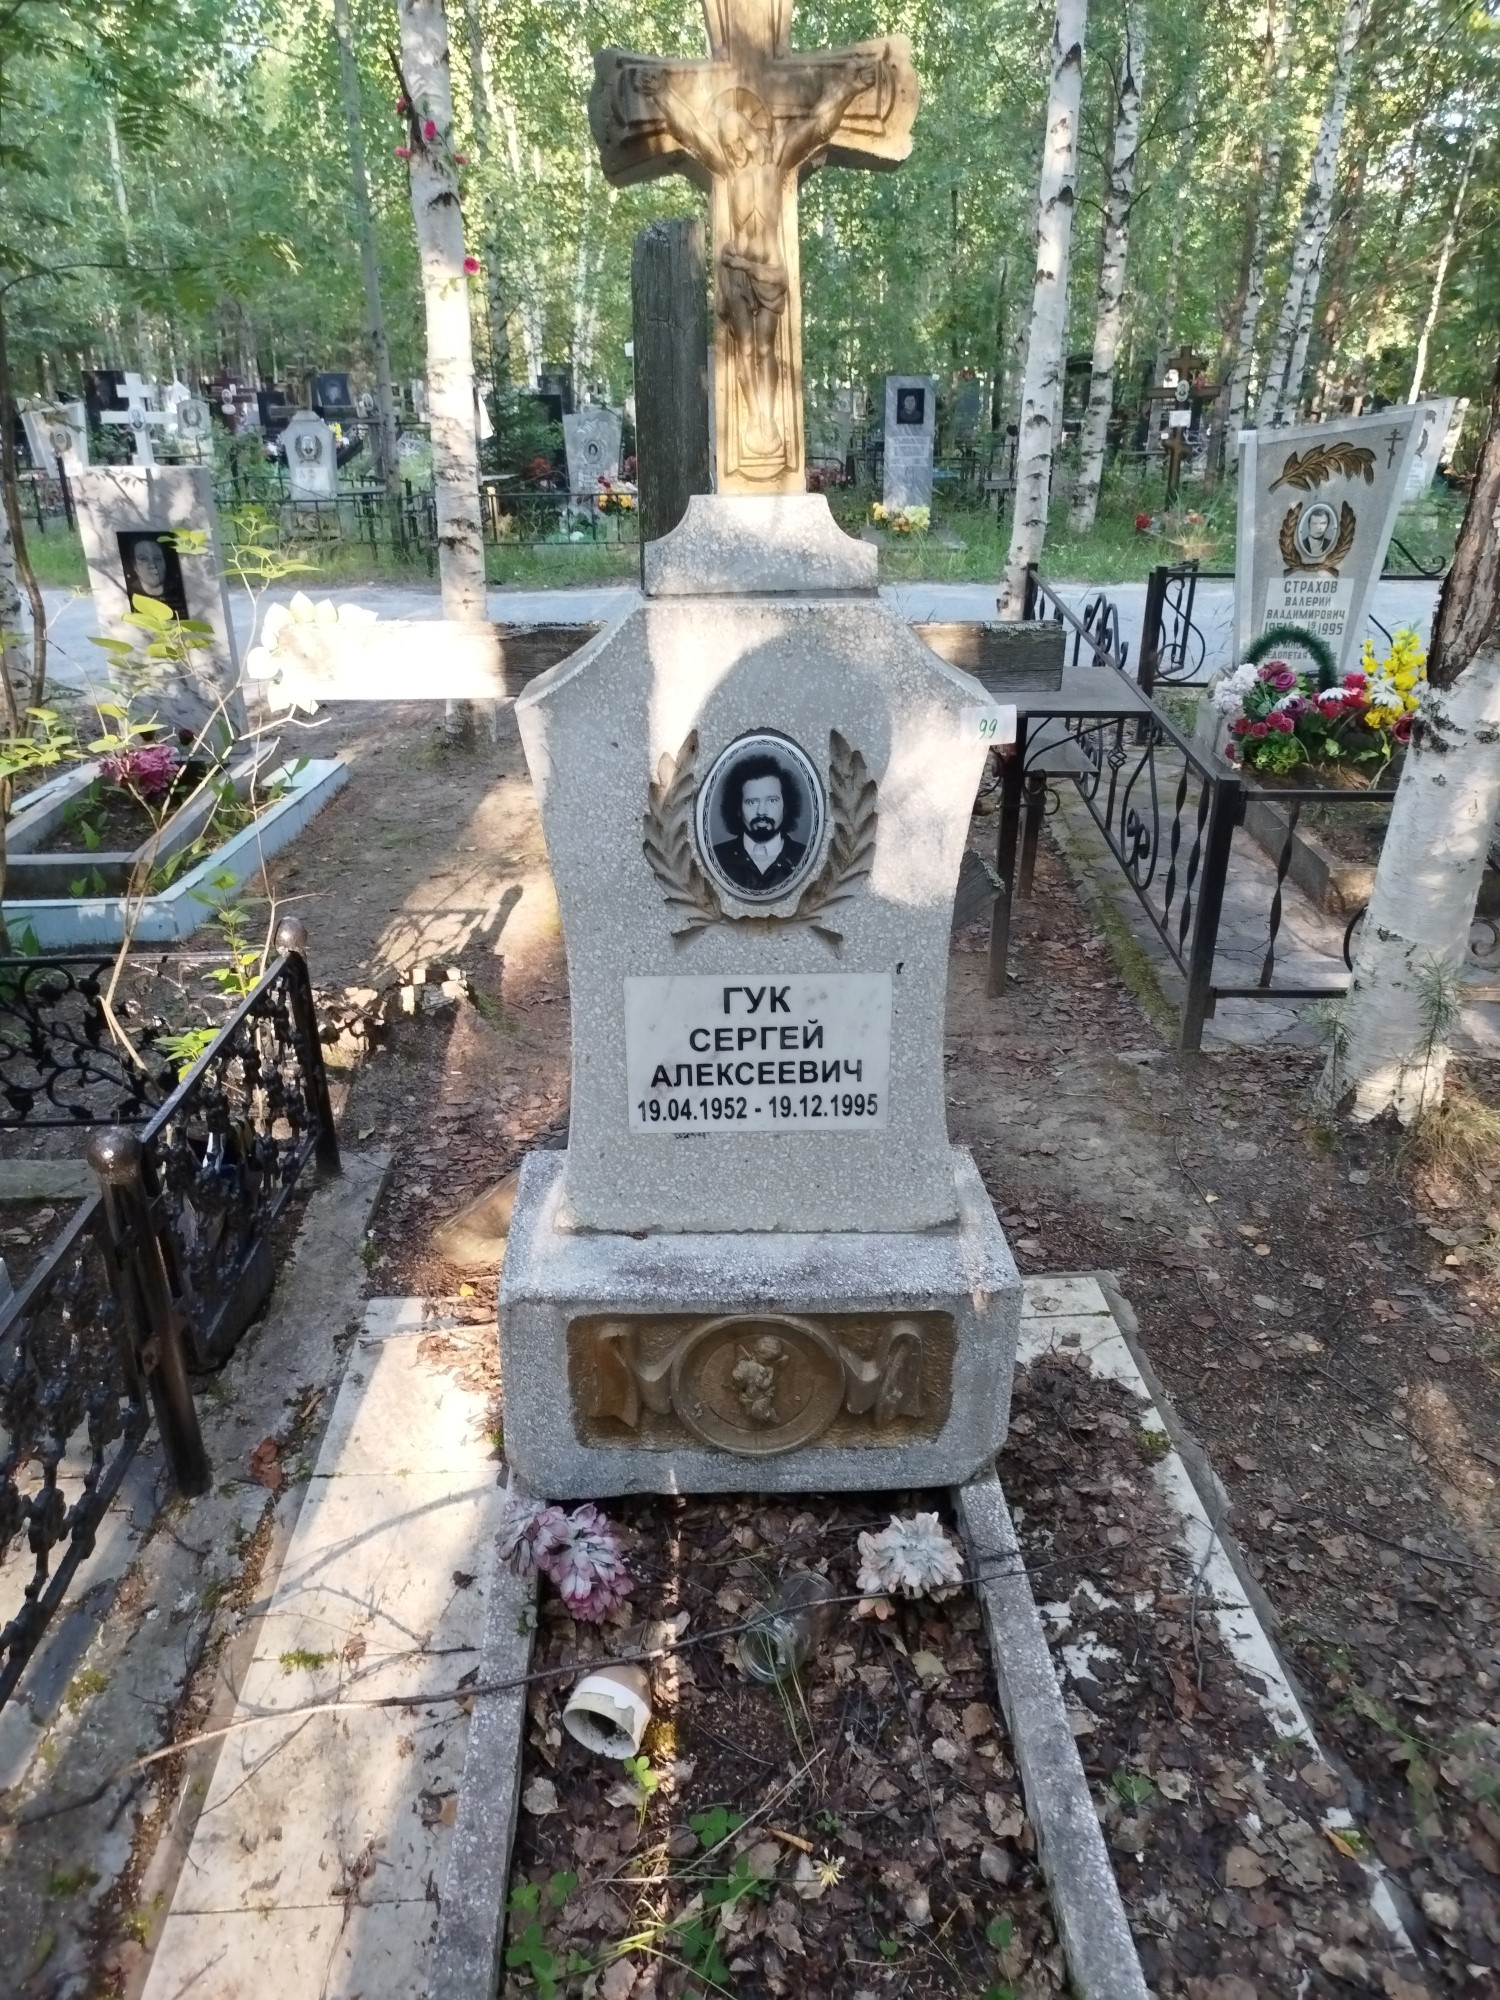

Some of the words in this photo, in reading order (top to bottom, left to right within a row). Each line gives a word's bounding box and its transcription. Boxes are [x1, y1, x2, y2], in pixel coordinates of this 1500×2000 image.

[1284, 580, 1338, 594] СТРАХОВ
[1266, 609, 1346, 620] ВЛАДИМИРОВИЧ
[1317, 622, 1344, 636] 1995
[979, 718, 998, 740] 99
[722, 985, 792, 1014] ГУК
[689, 1018, 824, 1052] СЕРГЕЙ
[650, 1058, 863, 1088] АЛЕКСЕЕВИЧ
[637, 1097, 747, 1122] 19.04.1952
[768, 1093, 878, 1118] 19.12.1995
